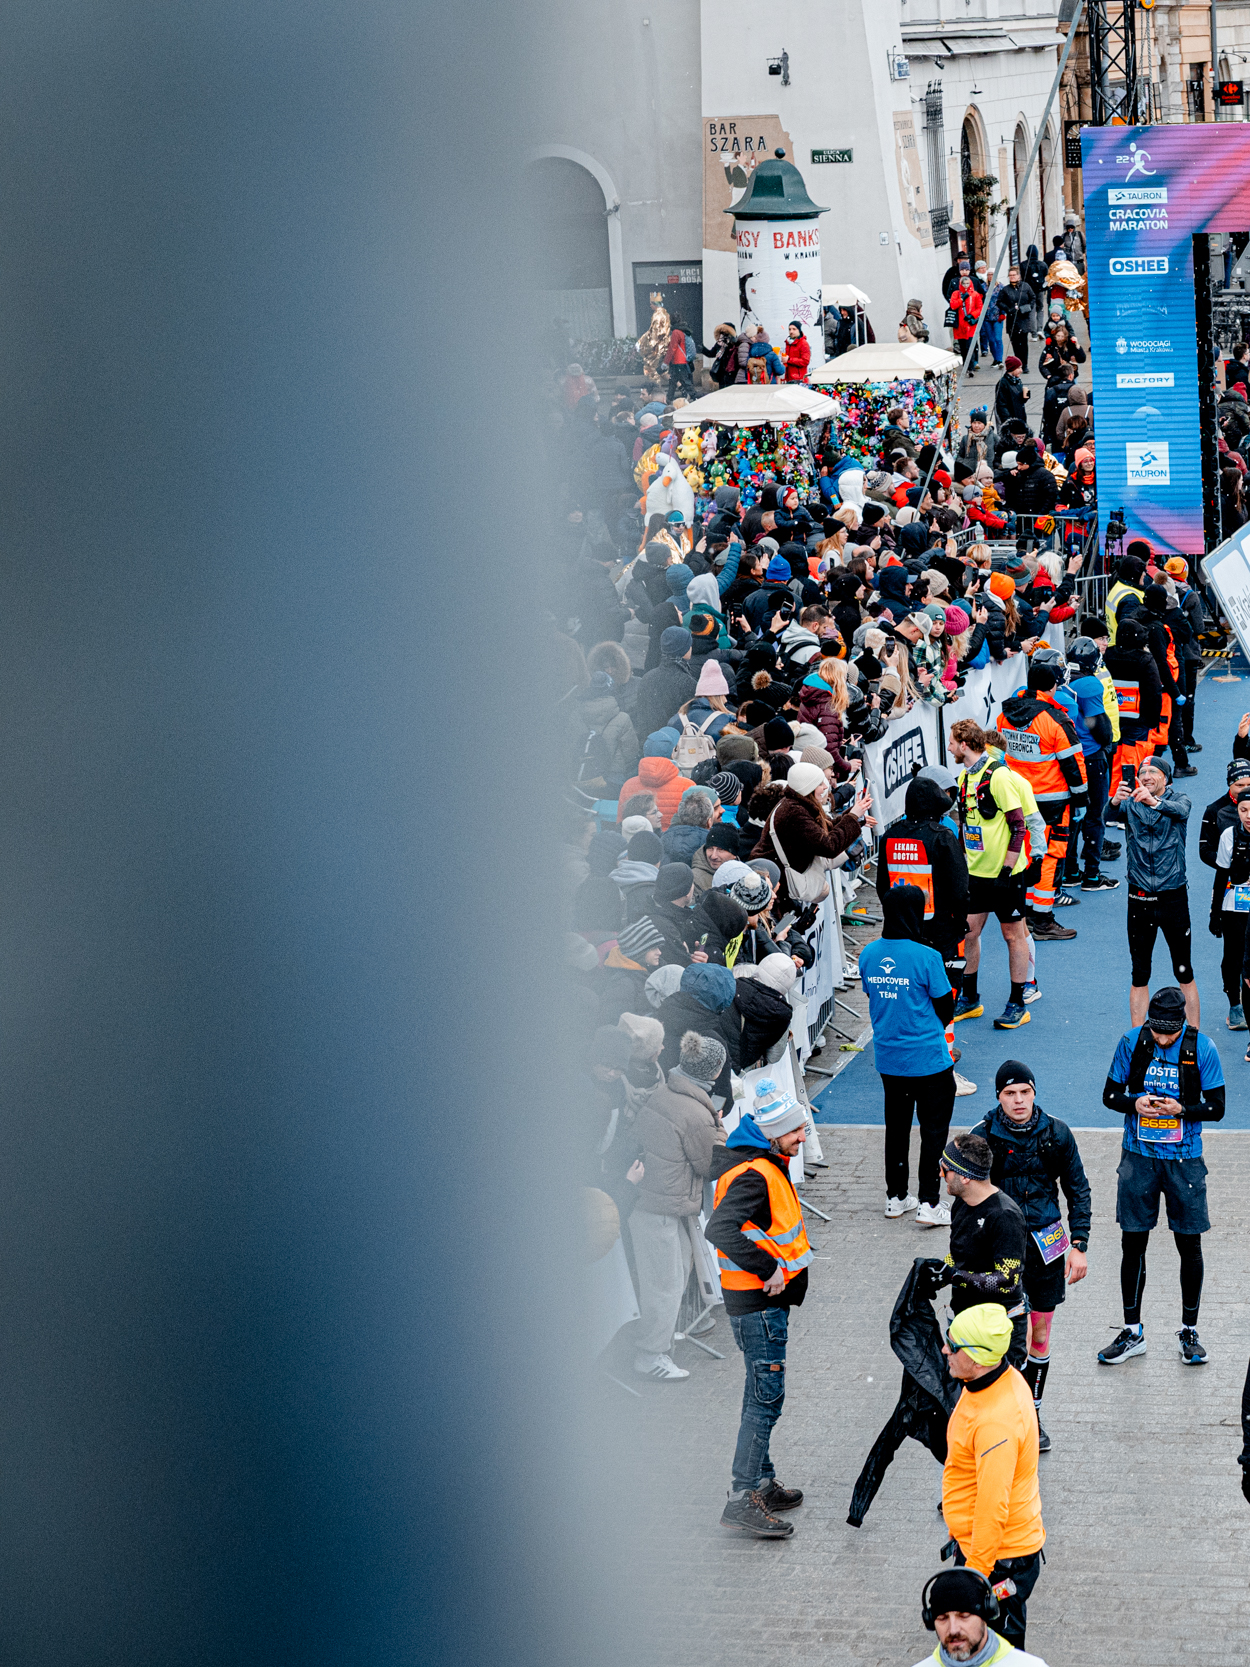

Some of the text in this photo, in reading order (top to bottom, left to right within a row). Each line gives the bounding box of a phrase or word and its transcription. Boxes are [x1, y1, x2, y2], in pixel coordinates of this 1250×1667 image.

[709, 122, 737, 135] BAR
[710, 136, 767, 152] SZARA
[813, 154, 850, 163] SIENNA
[1116, 155, 1130, 164] 22
[1127, 192, 1162, 200] TAURON
[1109, 208, 1169, 219] CRACOVIA
[1109, 220, 1168, 231] MARATON
[1112, 259, 1166, 272] OSHEE
[1130, 469, 1167, 478] TAURON
[885, 734, 924, 790] OSHEE
[894, 843, 918, 851] LEKARZ
[893, 852, 918, 861] DOCTOR
[867, 976, 910, 985] MEDICOVER
[879, 991, 898, 999] TEAM
[1141, 1117, 1178, 1129] 2659
